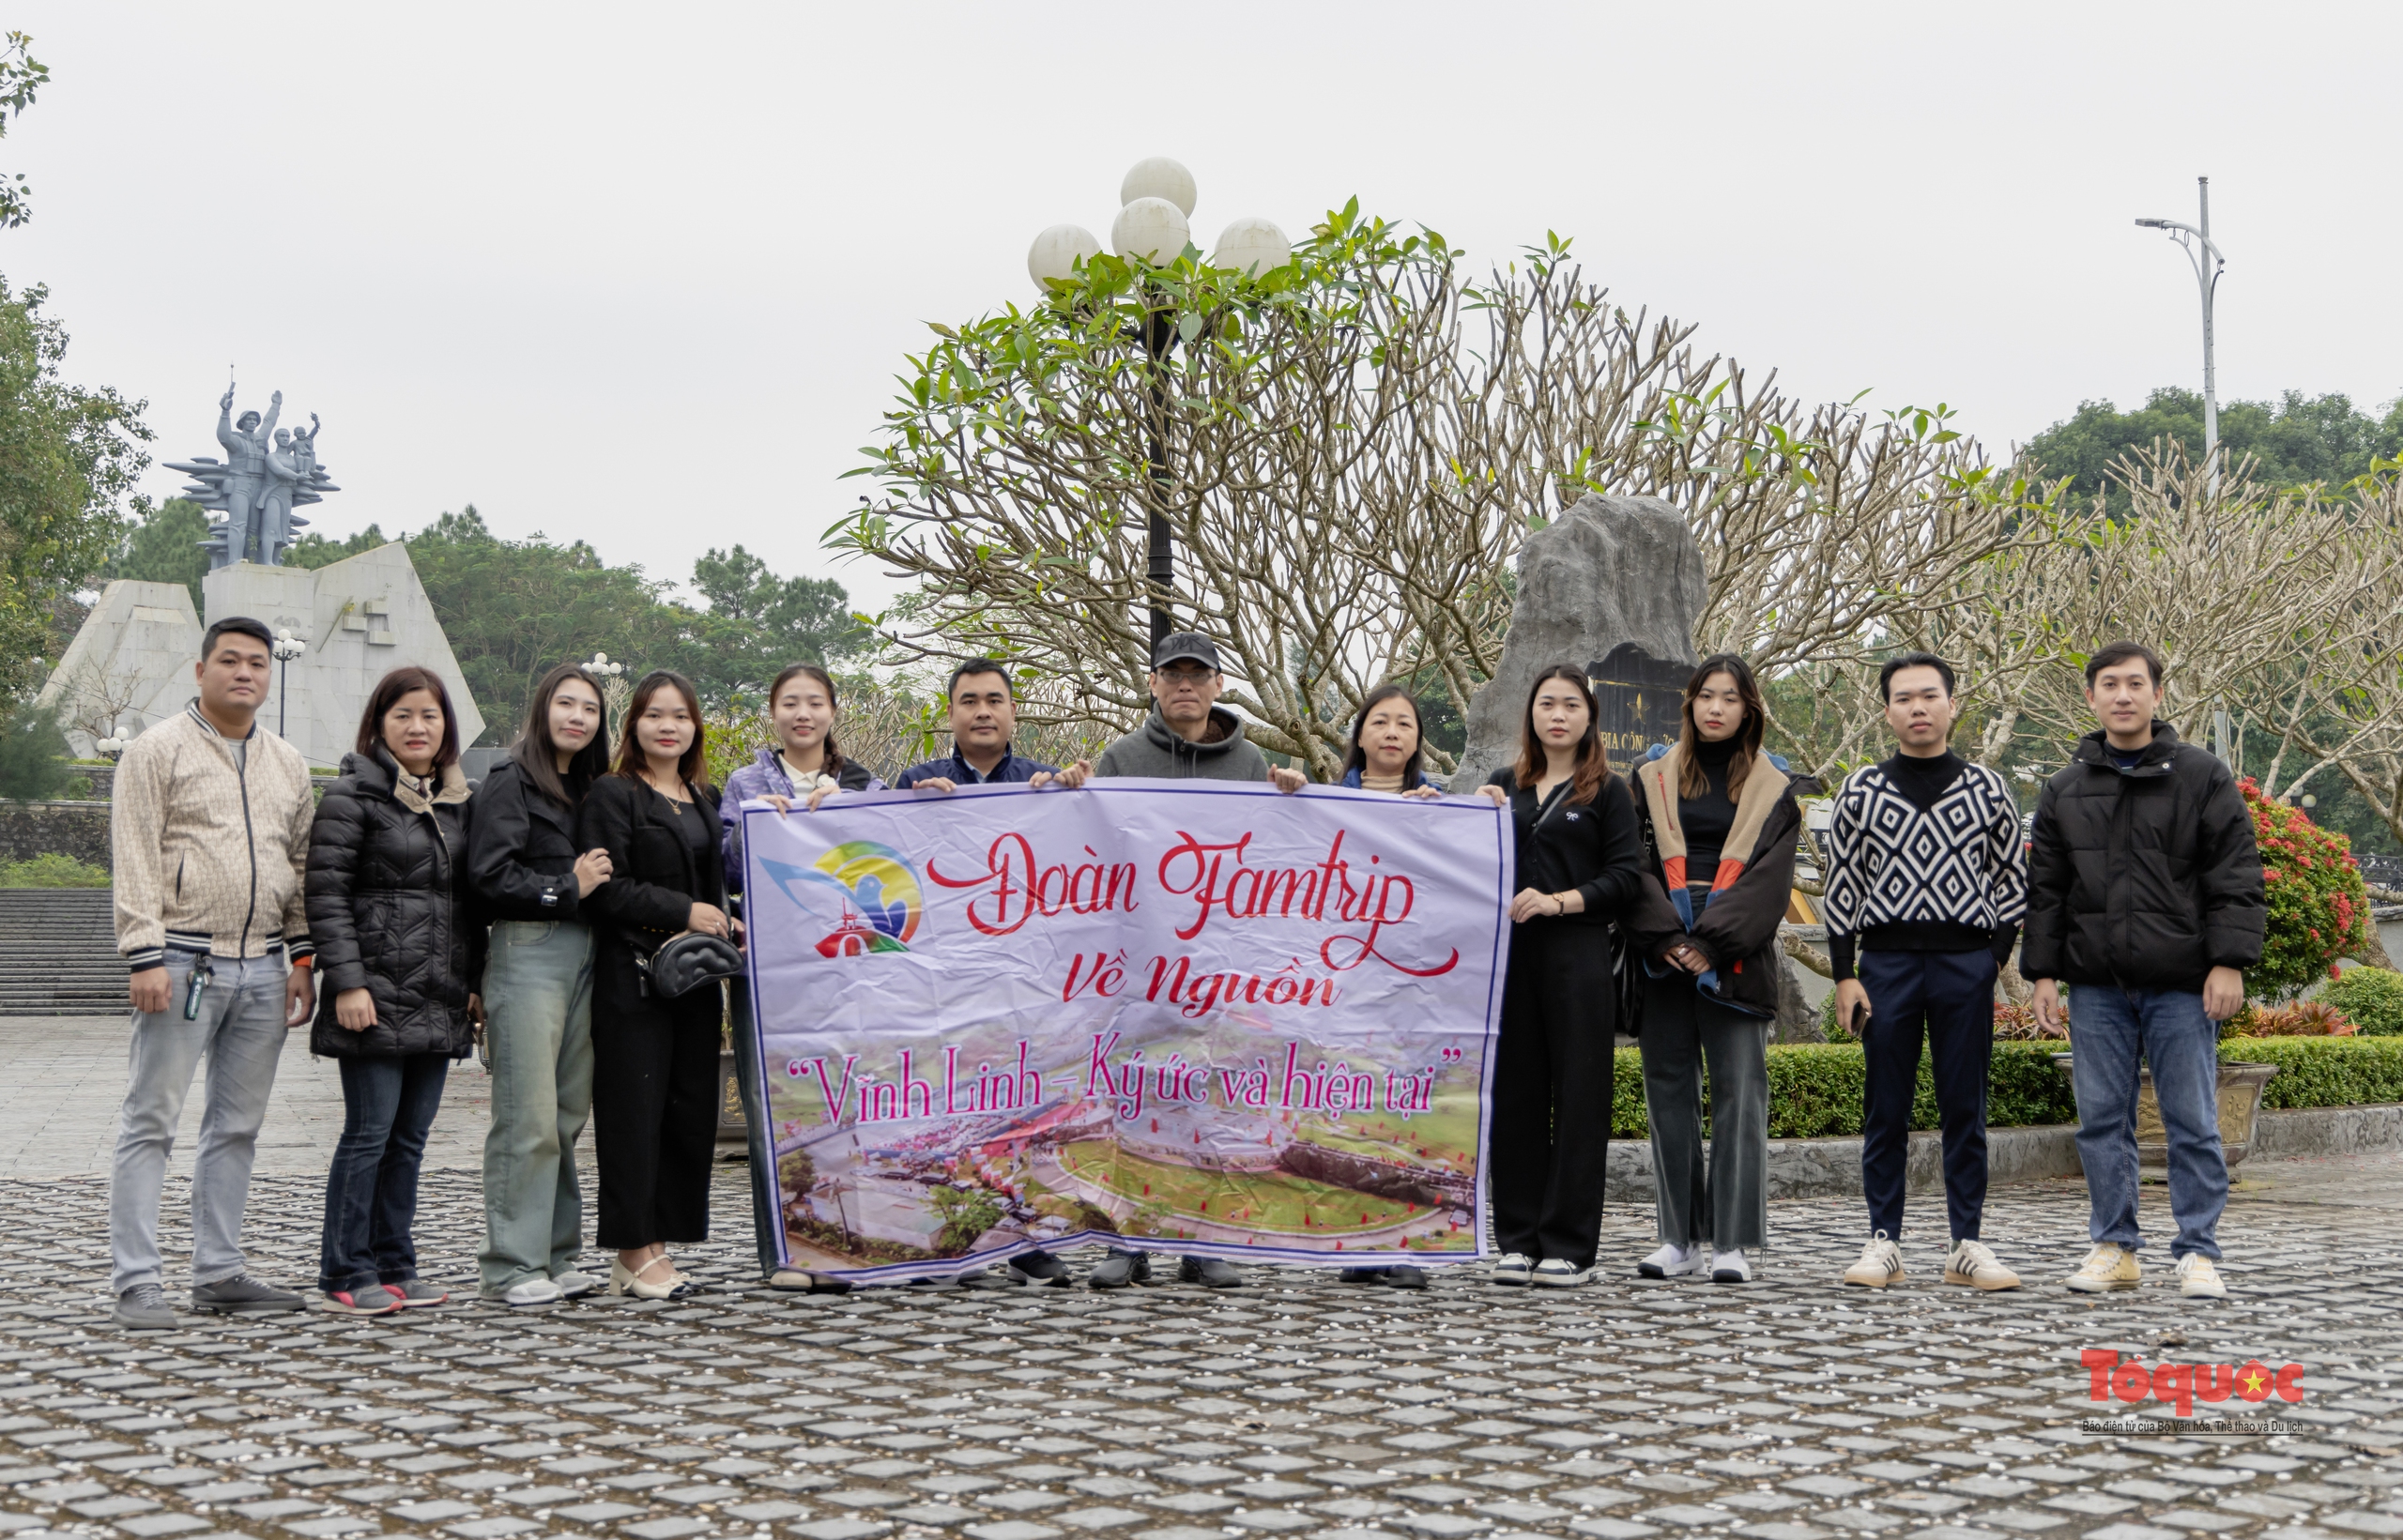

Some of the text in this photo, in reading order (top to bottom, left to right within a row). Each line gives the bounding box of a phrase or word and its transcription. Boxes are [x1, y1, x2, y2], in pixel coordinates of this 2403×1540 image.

[1599, 731, 1619, 750] BIA
[926, 829, 1460, 978] Đoàn Famtrip
[1063, 948, 1343, 1019] Về Nguồn
[943, 1040, 1044, 1115] Linh
[1085, 1031, 1146, 1121] Ký
[1156, 1053, 1210, 1104] ức
[1219, 1058, 1269, 1106] và
[1279, 1040, 1375, 1119] hiện
